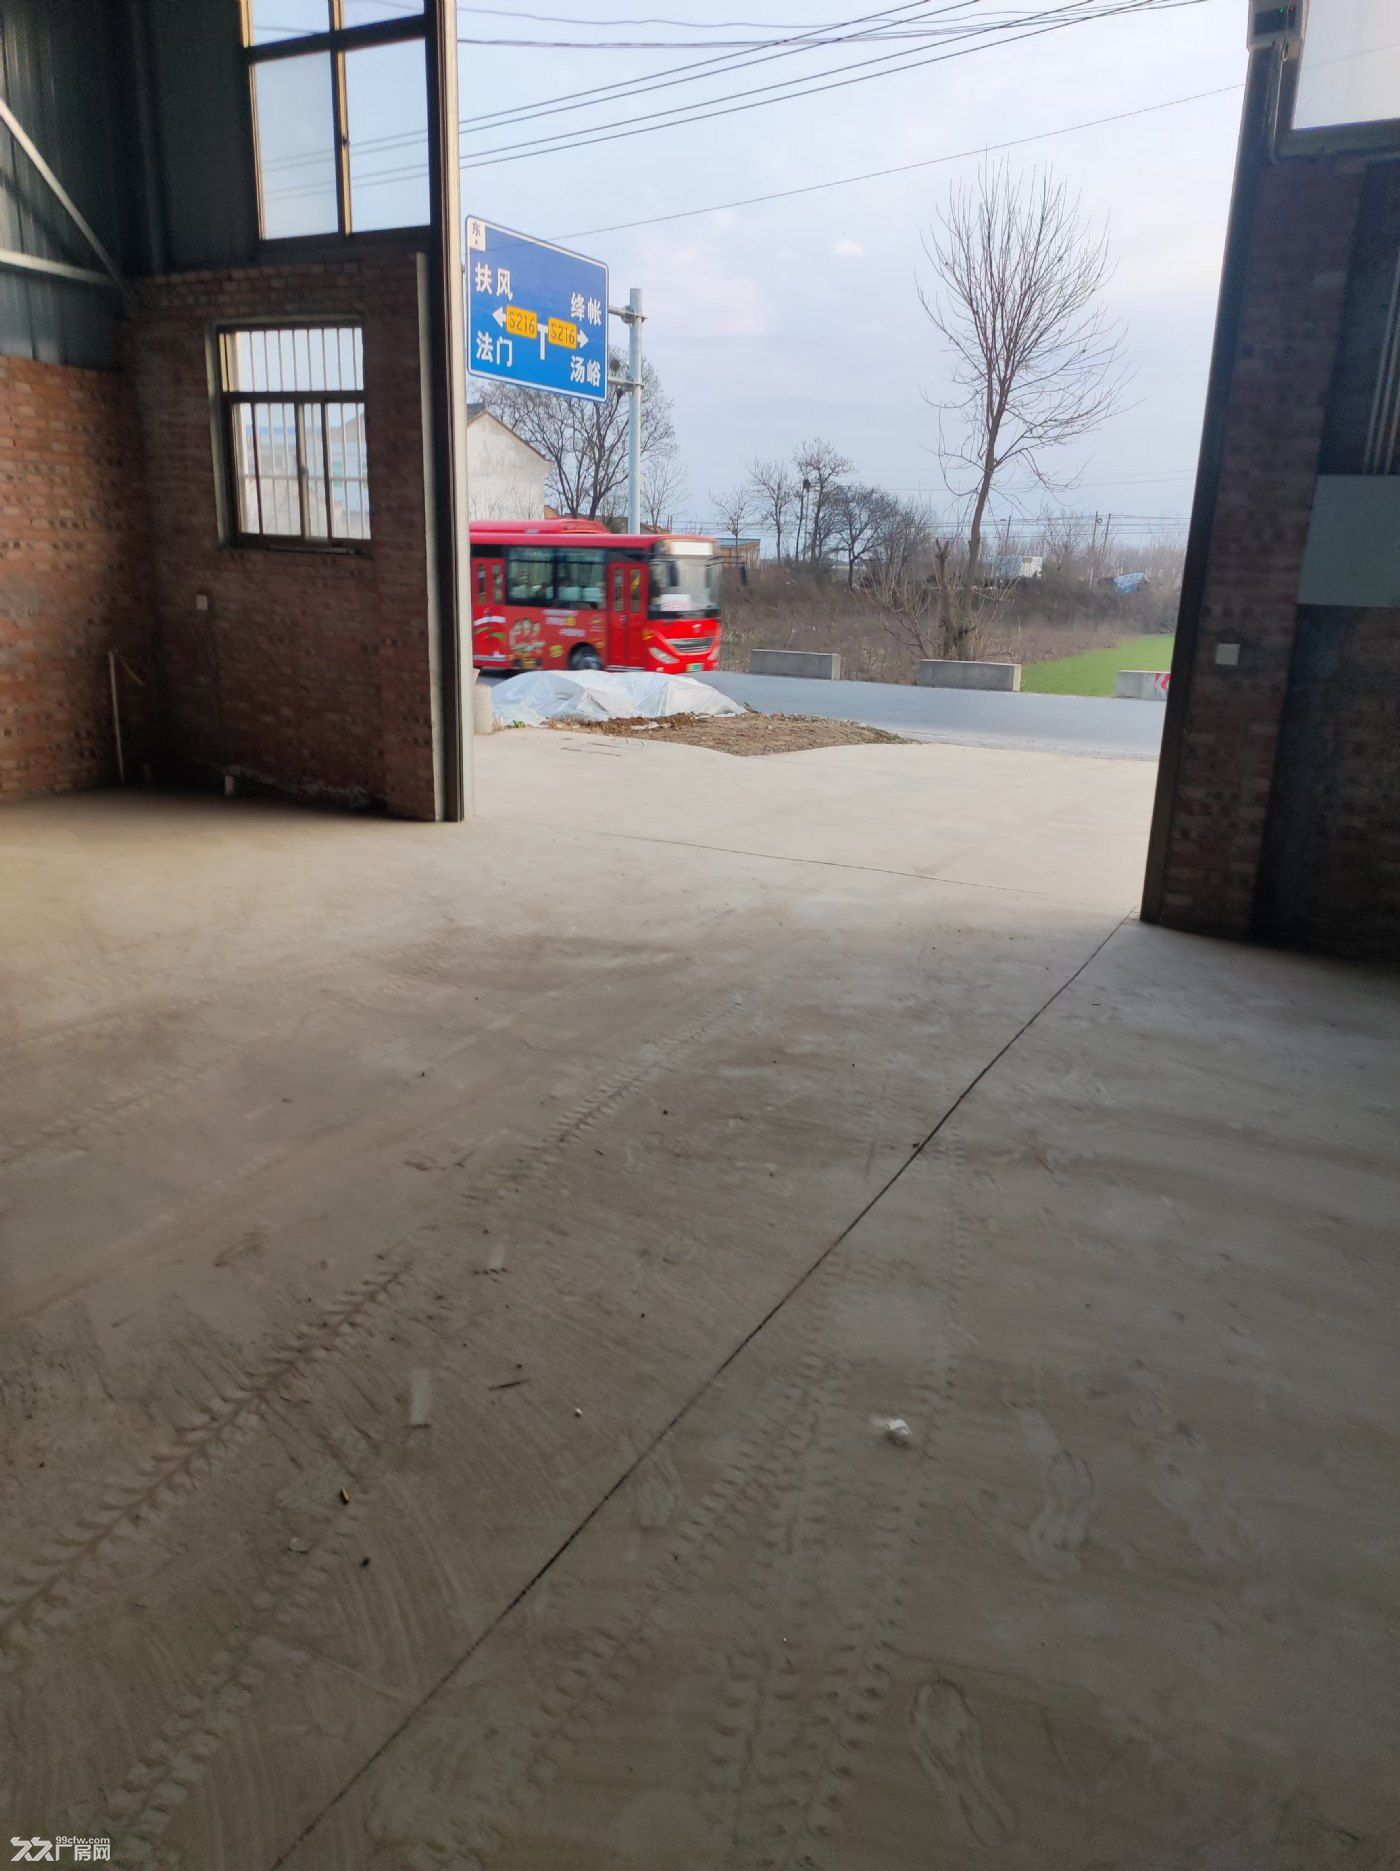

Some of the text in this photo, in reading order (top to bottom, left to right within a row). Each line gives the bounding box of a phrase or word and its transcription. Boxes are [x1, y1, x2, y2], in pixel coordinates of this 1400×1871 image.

[475, 262, 513, 301] 扶风
[508, 311, 536, 334] S216
[570, 291, 602, 326] 绛帐
[476, 330, 513, 367] 法门
[550, 323, 576, 345] S216
[570, 355, 601, 388] 汤峪
